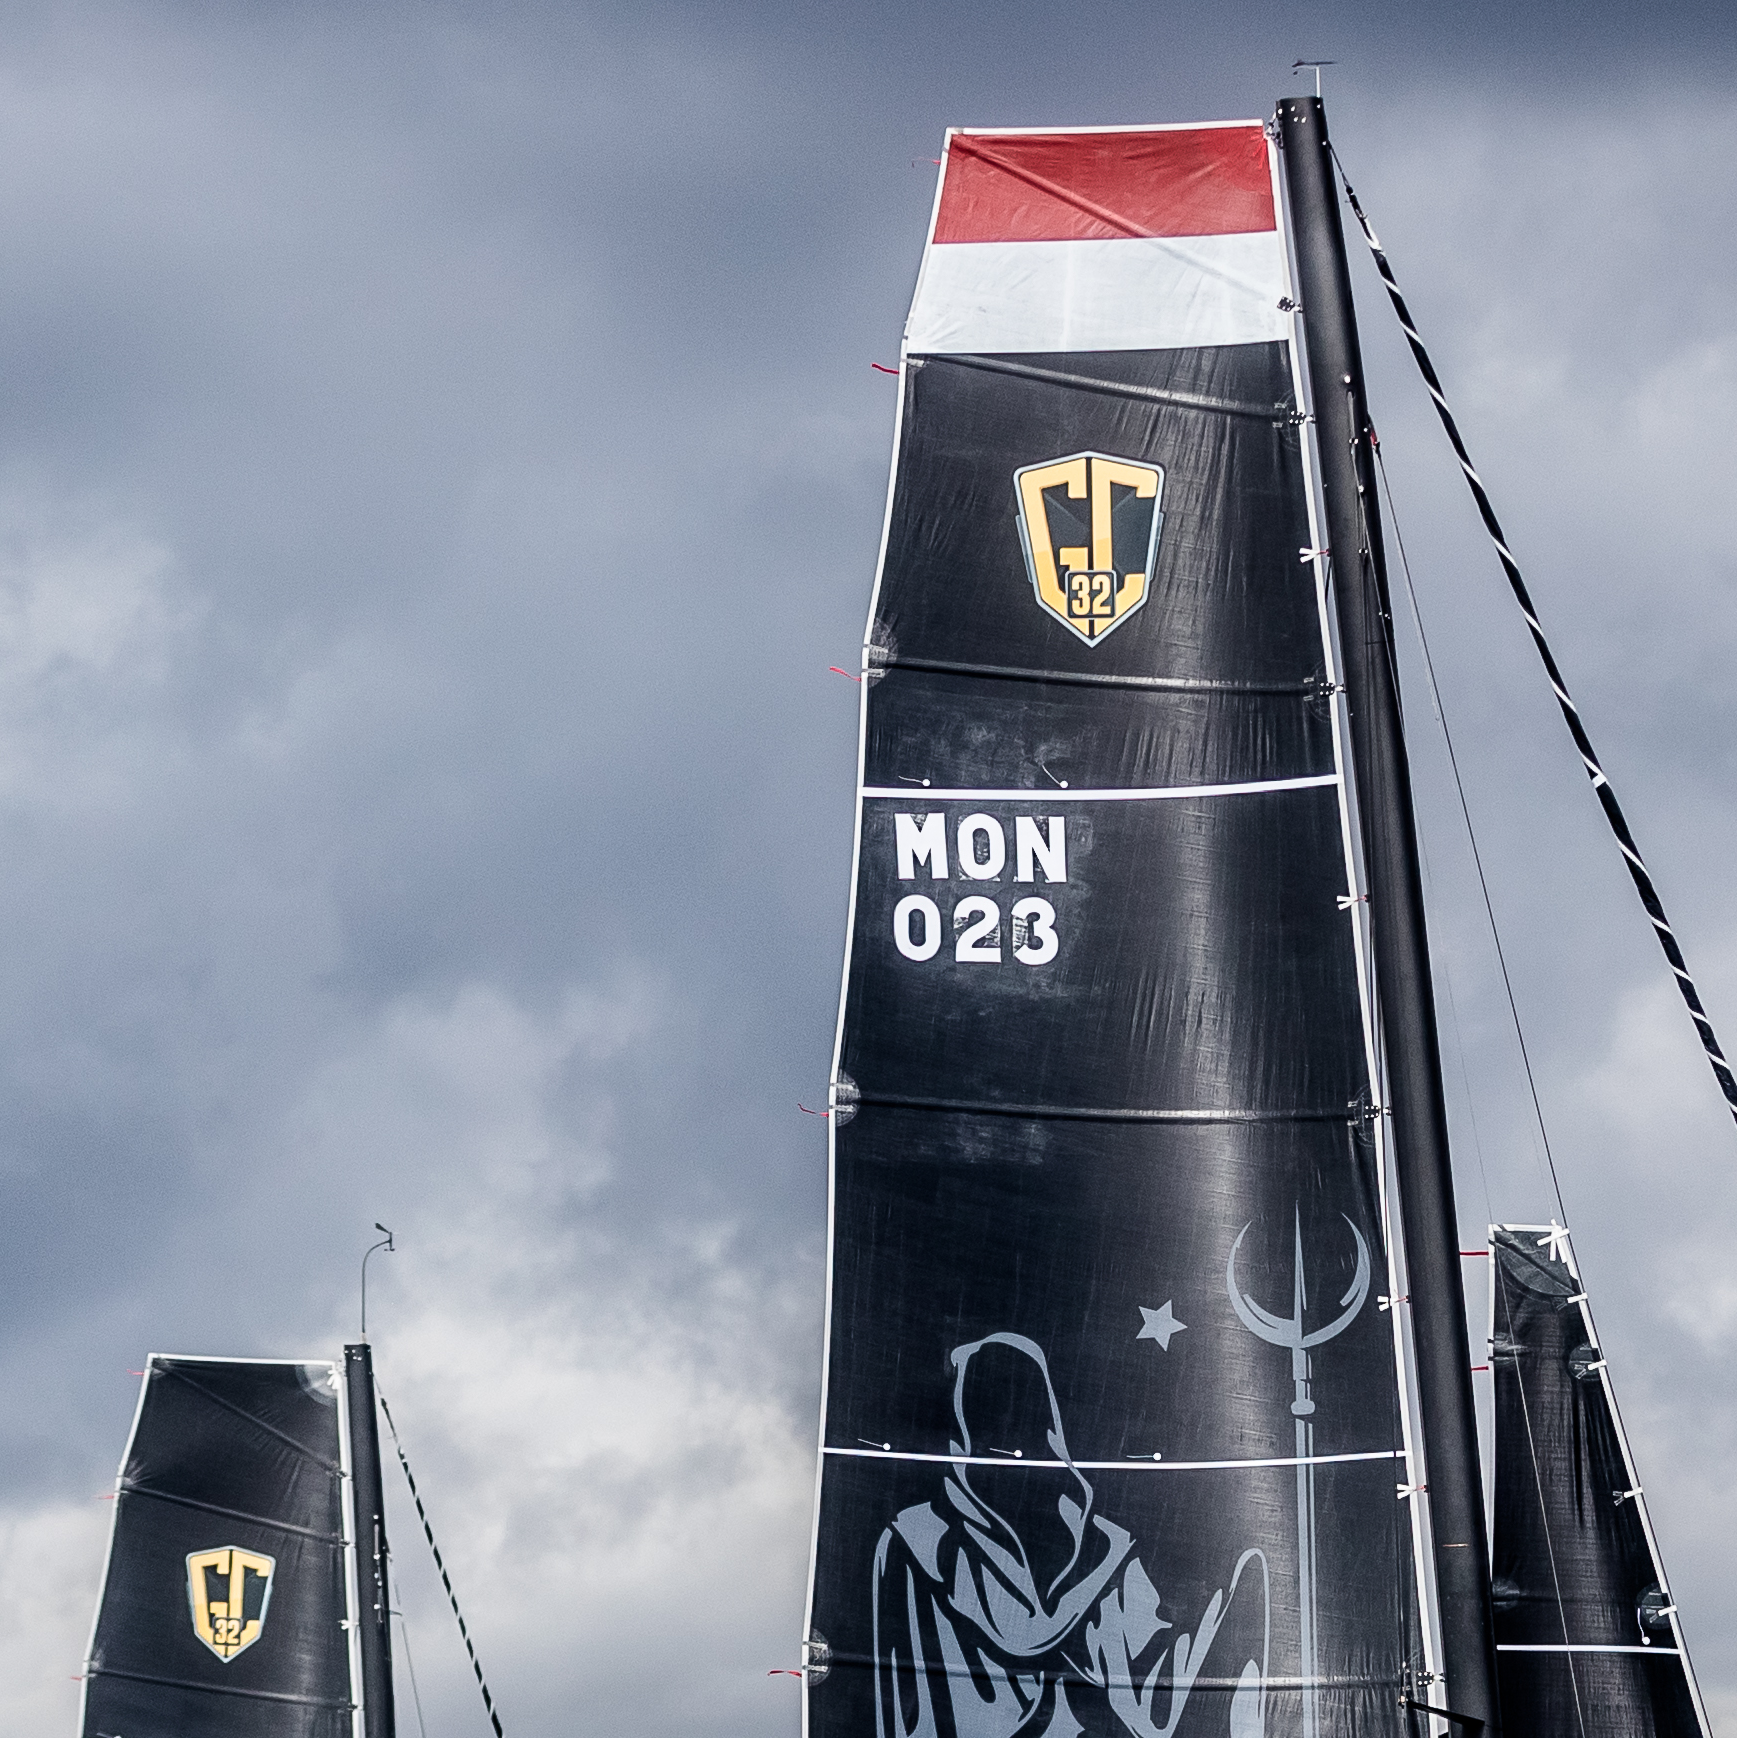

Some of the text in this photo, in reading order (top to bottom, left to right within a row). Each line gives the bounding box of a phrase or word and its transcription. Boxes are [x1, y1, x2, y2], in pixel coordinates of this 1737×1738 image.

[1071, 574, 1112, 616] 32
[894, 812, 1068, 884] MON
[893, 894, 1060, 967] 023
[213, 1618, 243, 1644] 32
